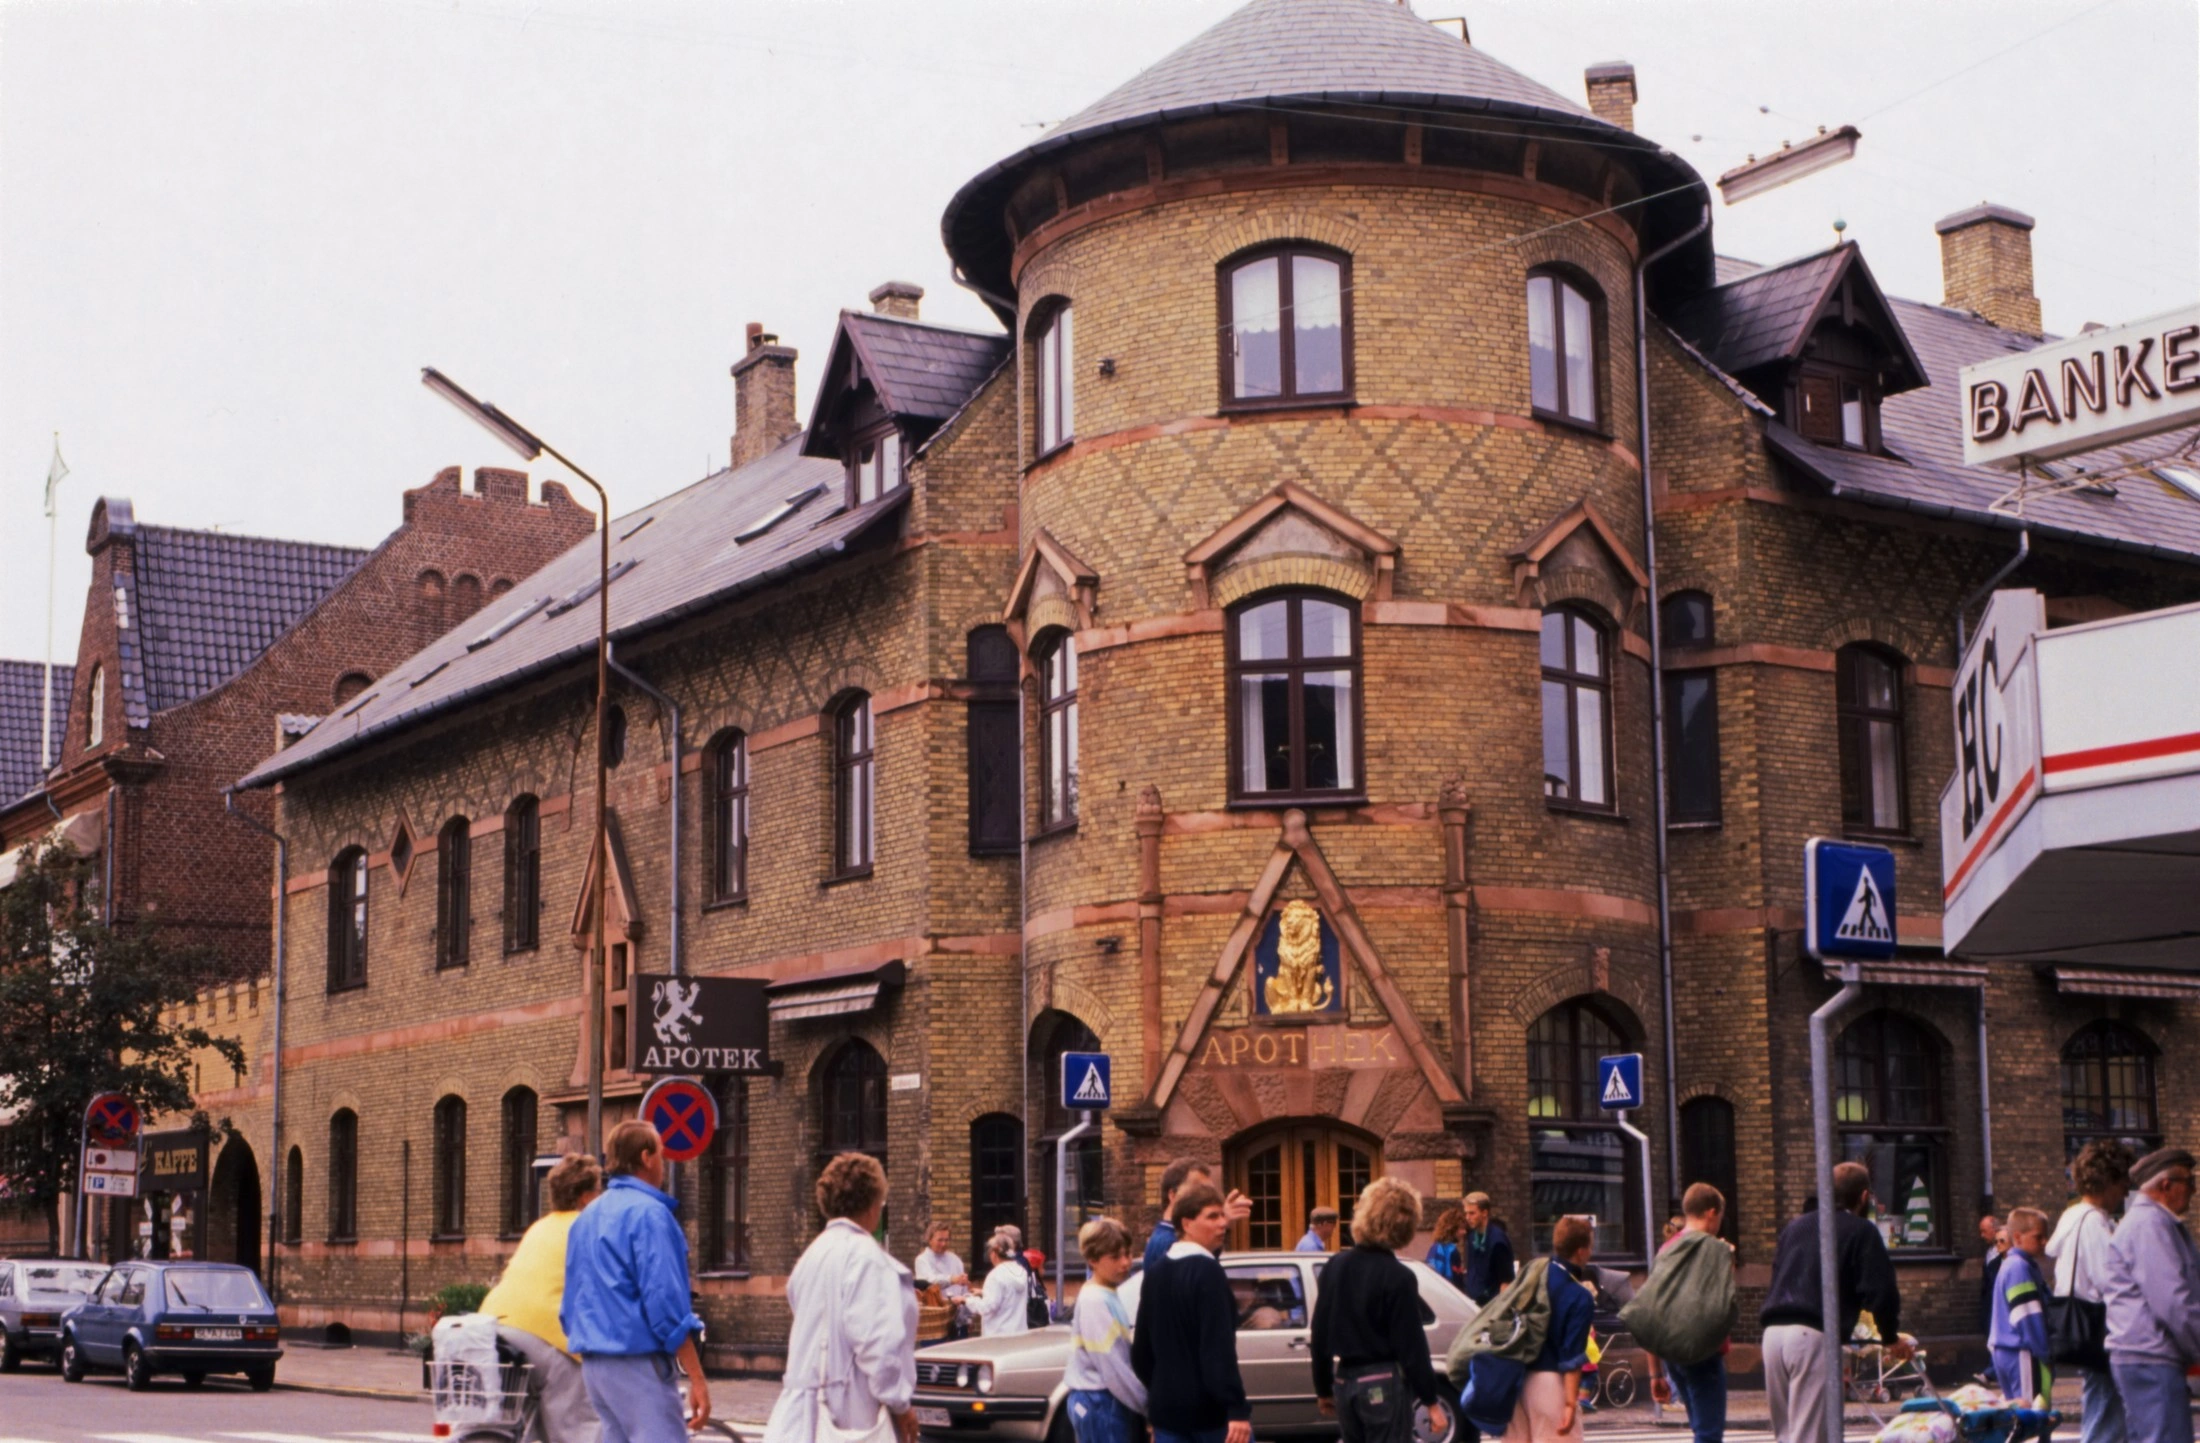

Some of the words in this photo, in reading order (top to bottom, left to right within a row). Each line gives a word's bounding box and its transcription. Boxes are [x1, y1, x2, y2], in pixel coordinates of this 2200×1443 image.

[1970, 324, 2200, 444] BANKE
[642, 1046, 762, 1069] APOTEK
[1200, 1032, 1397, 1066] APOTHEK
[154, 1148, 197, 1175] KAPPE
